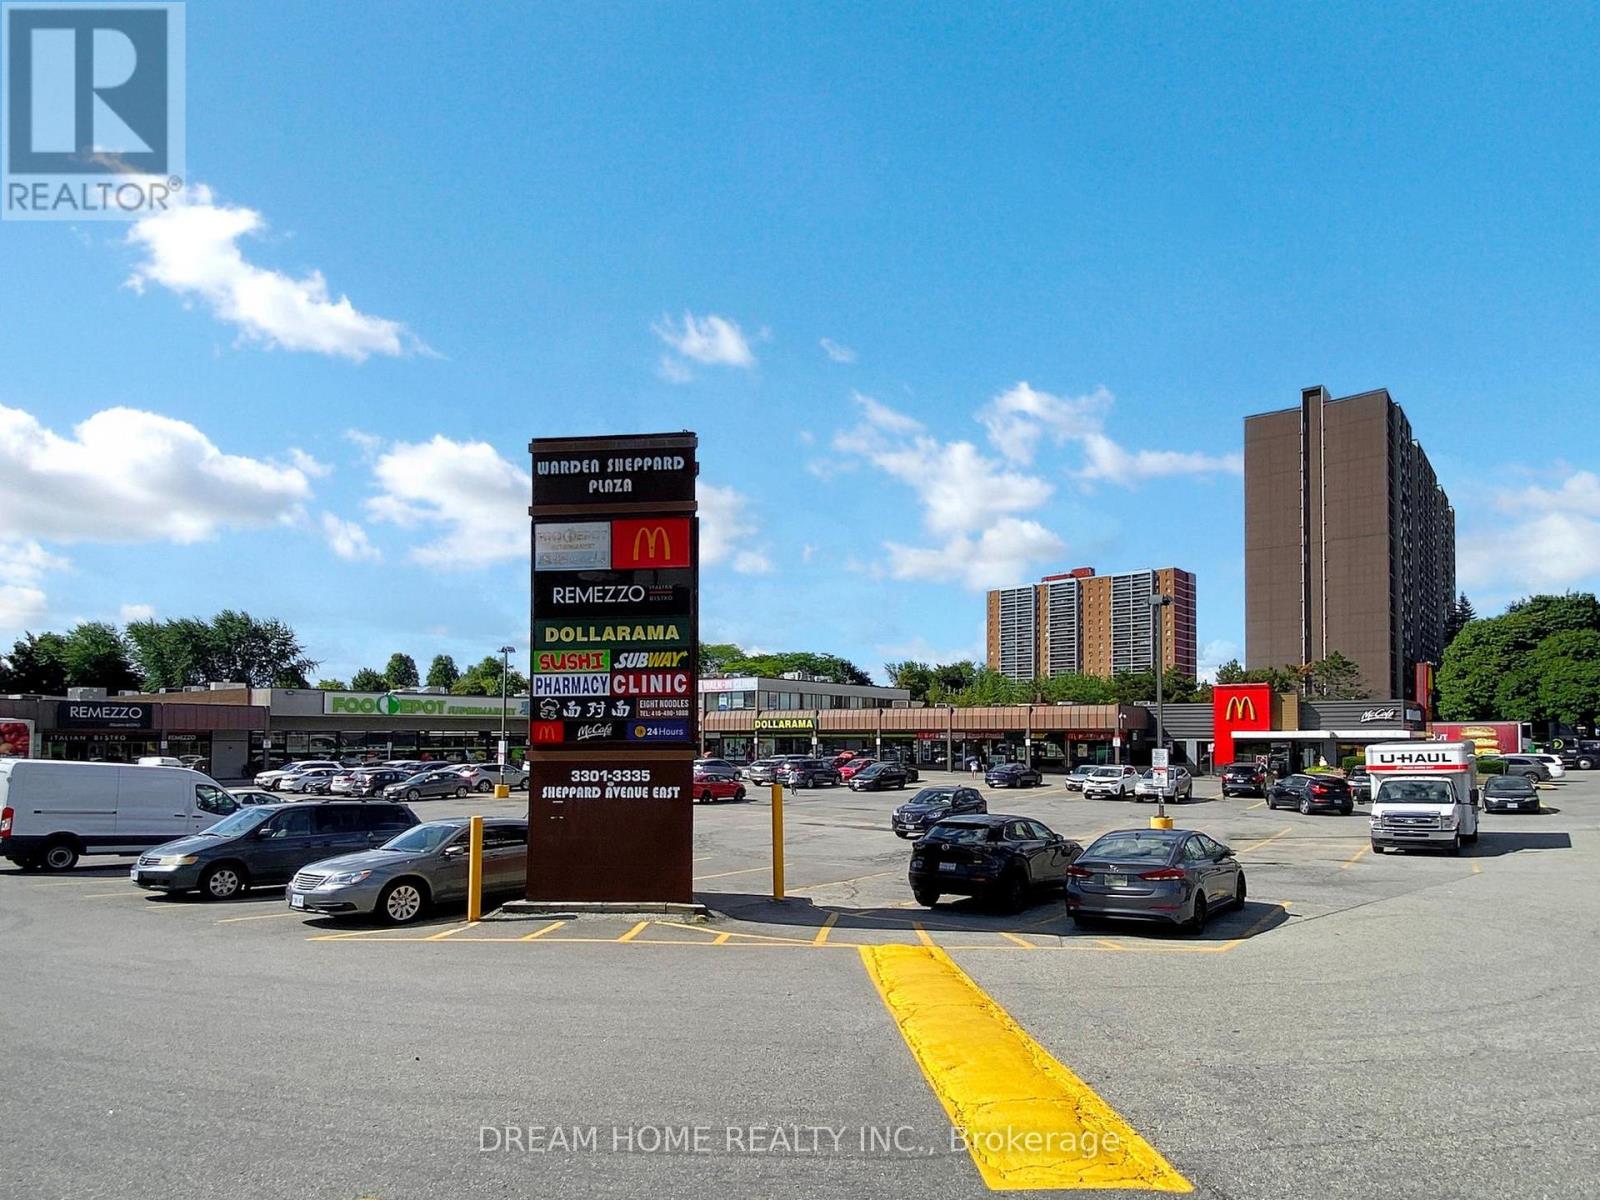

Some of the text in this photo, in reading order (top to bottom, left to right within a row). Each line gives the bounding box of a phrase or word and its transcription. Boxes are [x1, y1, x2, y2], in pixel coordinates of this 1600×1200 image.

[537, 456, 685, 475] WARDEN SHEPPARD
[588, 479, 633, 493] PLAZA
[553, 585, 645, 604] REMEZZO
[545, 625, 680, 642] DOLLARAMA
[539, 652, 604, 670] SUSHI
[614, 651, 688, 669] SUBWAY
[536, 676, 608, 695] PHARMACY
[612, 674, 687, 693] CLINIC
[640, 699, 689, 708] EIGHT NOODLES
[70, 706, 142, 719] REMEZZO
[646, 727, 684, 736] 24 Hours
[754, 720, 814, 729] DOLLARAMA
[1380, 753, 1452, 763] U-HAUL
[571, 770, 651, 782] 3301-3335
[542, 786, 680, 799] SHEPPARD AVENUE EAST
